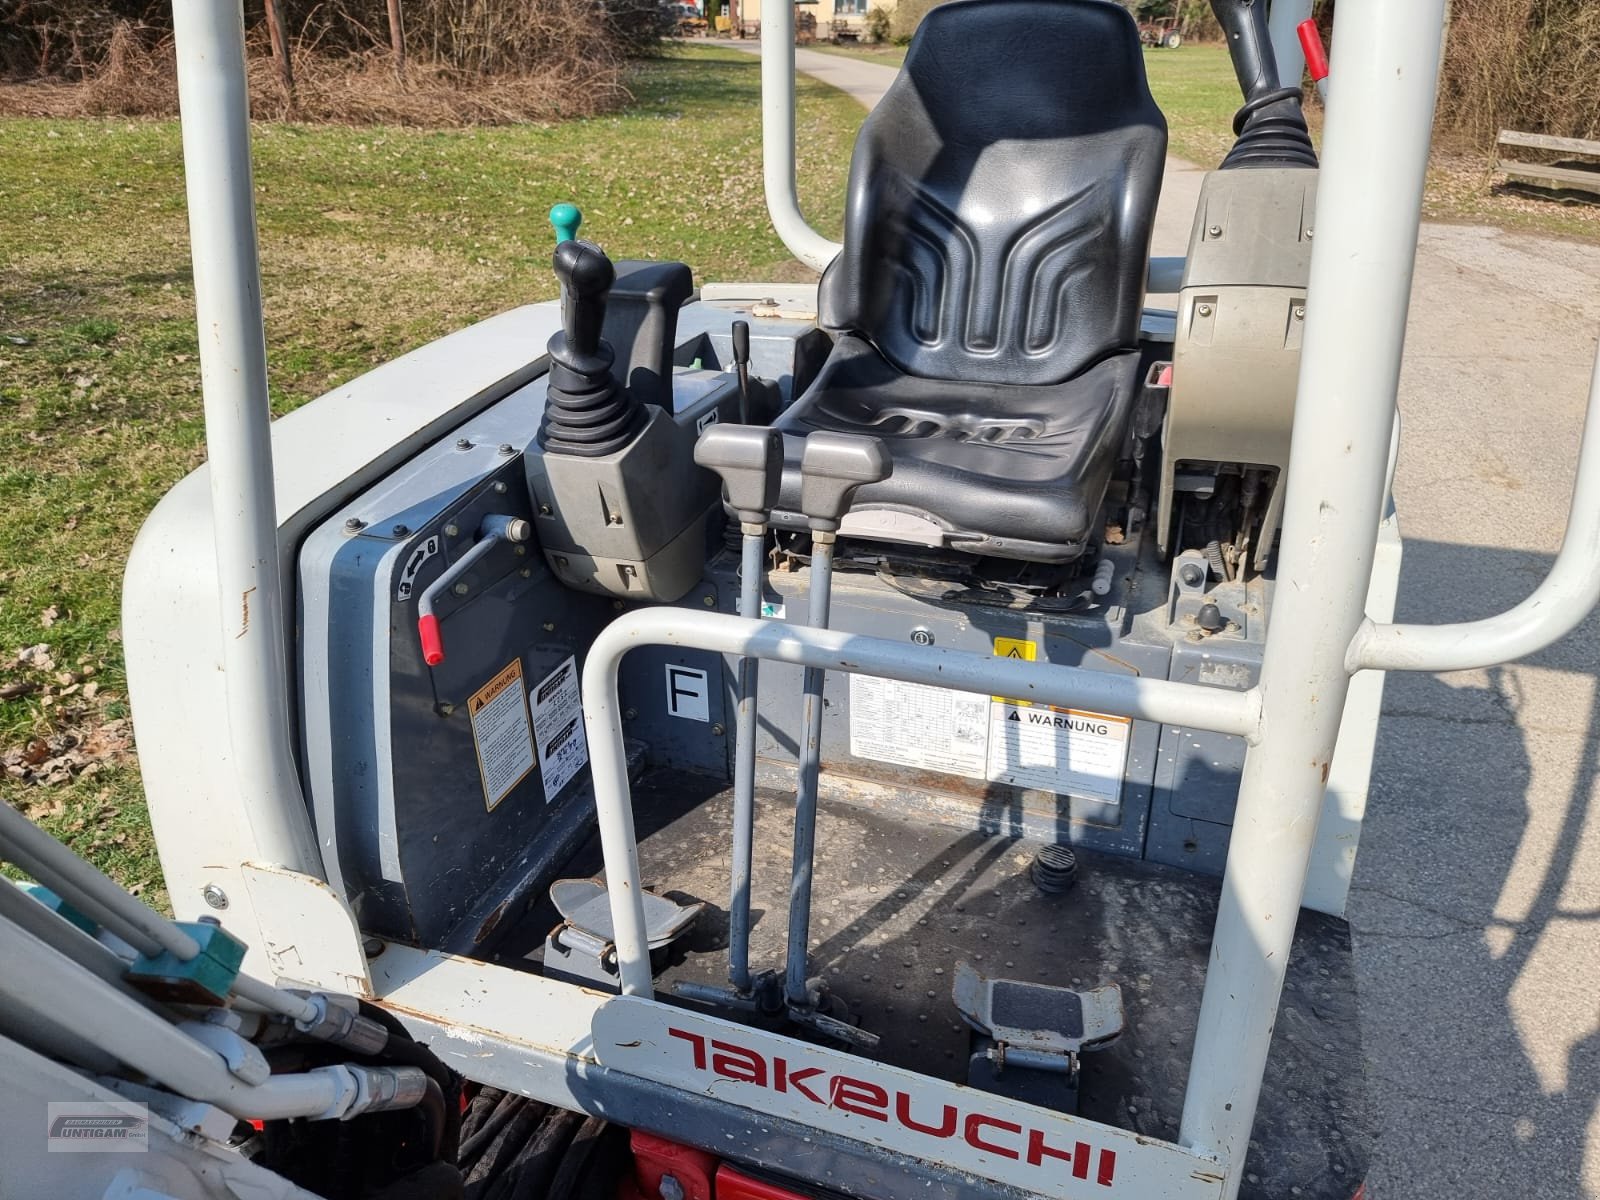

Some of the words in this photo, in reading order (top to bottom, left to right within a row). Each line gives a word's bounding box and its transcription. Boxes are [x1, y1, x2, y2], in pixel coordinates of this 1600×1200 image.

[484, 670, 516, 700] WARNUNG
[670, 669, 703, 712] F
[1028, 713, 1108, 735] WARNUNG
